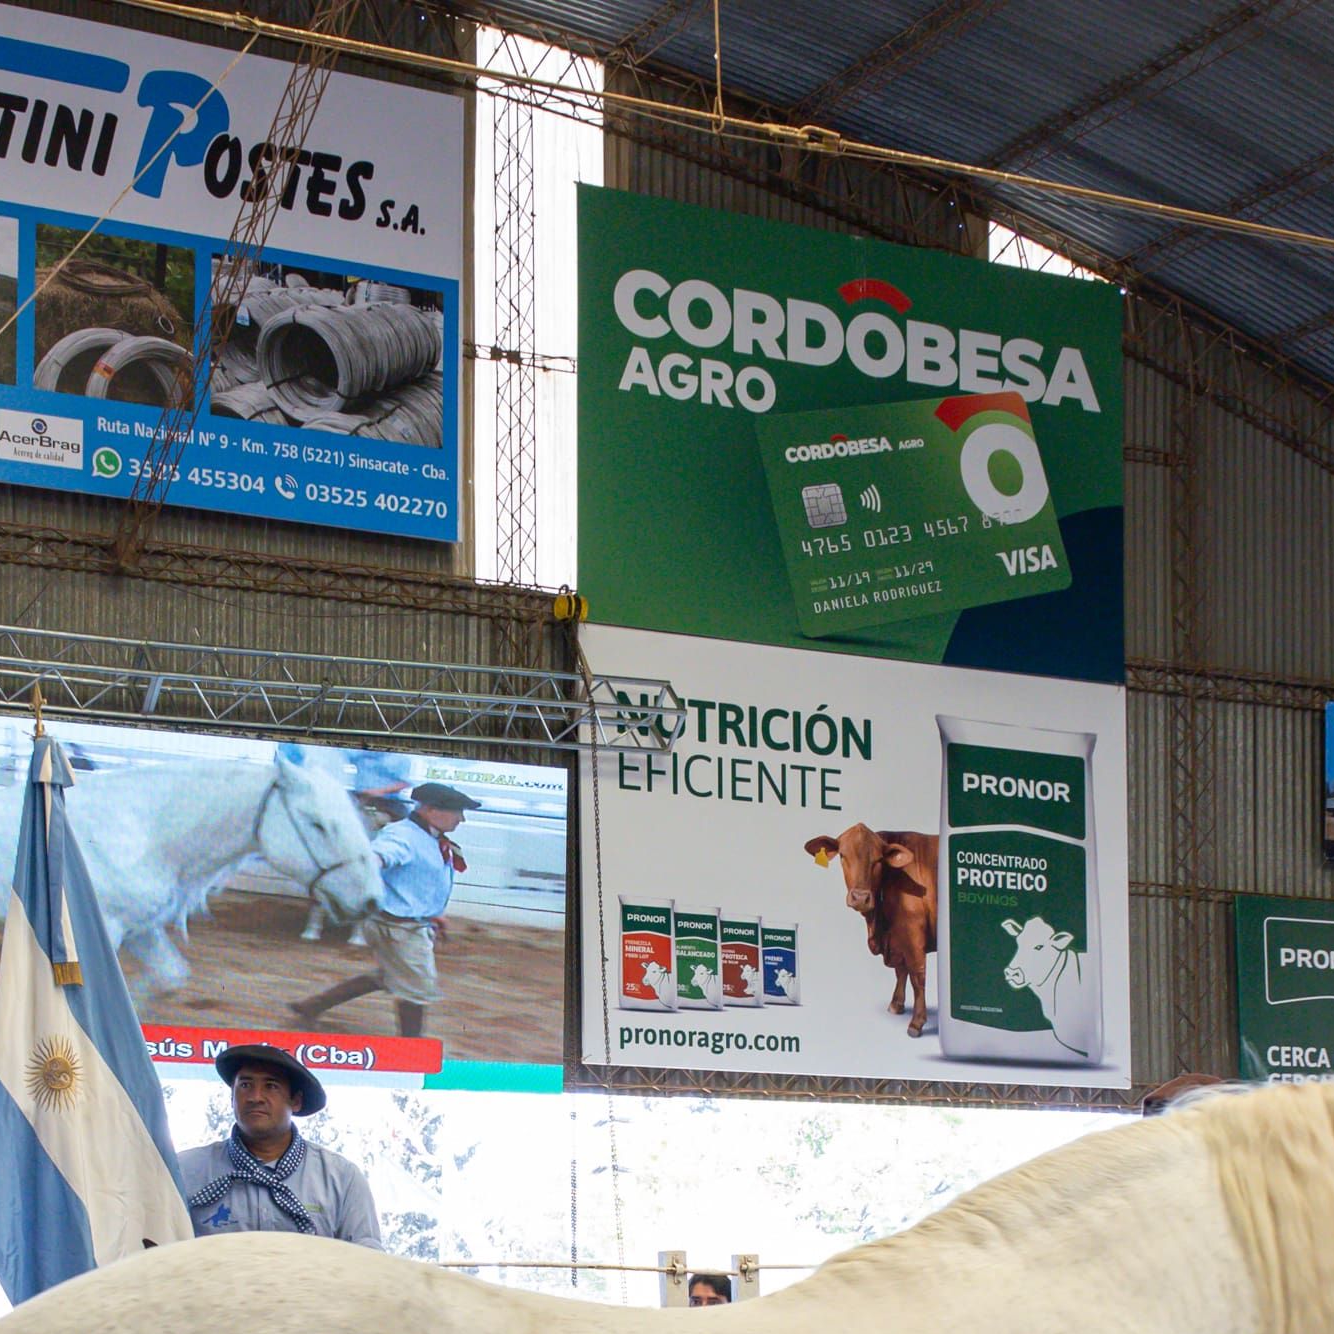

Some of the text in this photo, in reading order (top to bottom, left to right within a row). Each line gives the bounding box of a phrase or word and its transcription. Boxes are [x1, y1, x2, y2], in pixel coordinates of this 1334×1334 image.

[133, 70, 374, 220] POSTES
[376, 199, 426, 235] S.A.
[614, 269, 1101, 413] CORDOBESA
[618, 346, 776, 413] AGRO
[0, 430, 81, 454] AcerBrag
[97, 416, 130, 436] Ruta
[219, 435, 228, 449] 9
[242, 438, 267, 455] Km.
[273, 442, 299, 459] 758
[302, 446, 345, 468] (5221)
[349, 454, 409, 475] Sinsacate
[422, 464, 449, 481] Cba.
[785, 436, 925, 463] CORDOBESA AGRO
[128, 458, 448, 518] 3525 455304 03525 402270
[802, 534, 851, 557] 4765
[864, 525, 912, 547] 0123
[924, 516, 968, 537] 4567
[829, 571, 870, 589] 11/19
[894, 560, 933, 578] 11/29
[995, 545, 1058, 576] VISA
[814, 581, 942, 613] DANIELA RODRIGUEZ
[617, 691, 872, 760] NUTRICIÓN
[619, 752, 842, 811] EFICIENTE
[962, 771, 1071, 802] PRONOR
[957, 851, 1047, 871] CONCENTRADO
[957, 867, 1047, 892] PROTEICO
[958, 892, 1018, 907] BOVINOS
[627, 913, 666, 924] PRONOR
[678, 921, 713, 930] PRONOR
[723, 928, 755, 936] PRONOR
[764, 934, 792, 942] PRONOR
[619, 1024, 801, 1053] pronoragro.com
[295, 1043, 375, 1070] (Cba)
[1267, 1045, 1331, 1068] CERCA
